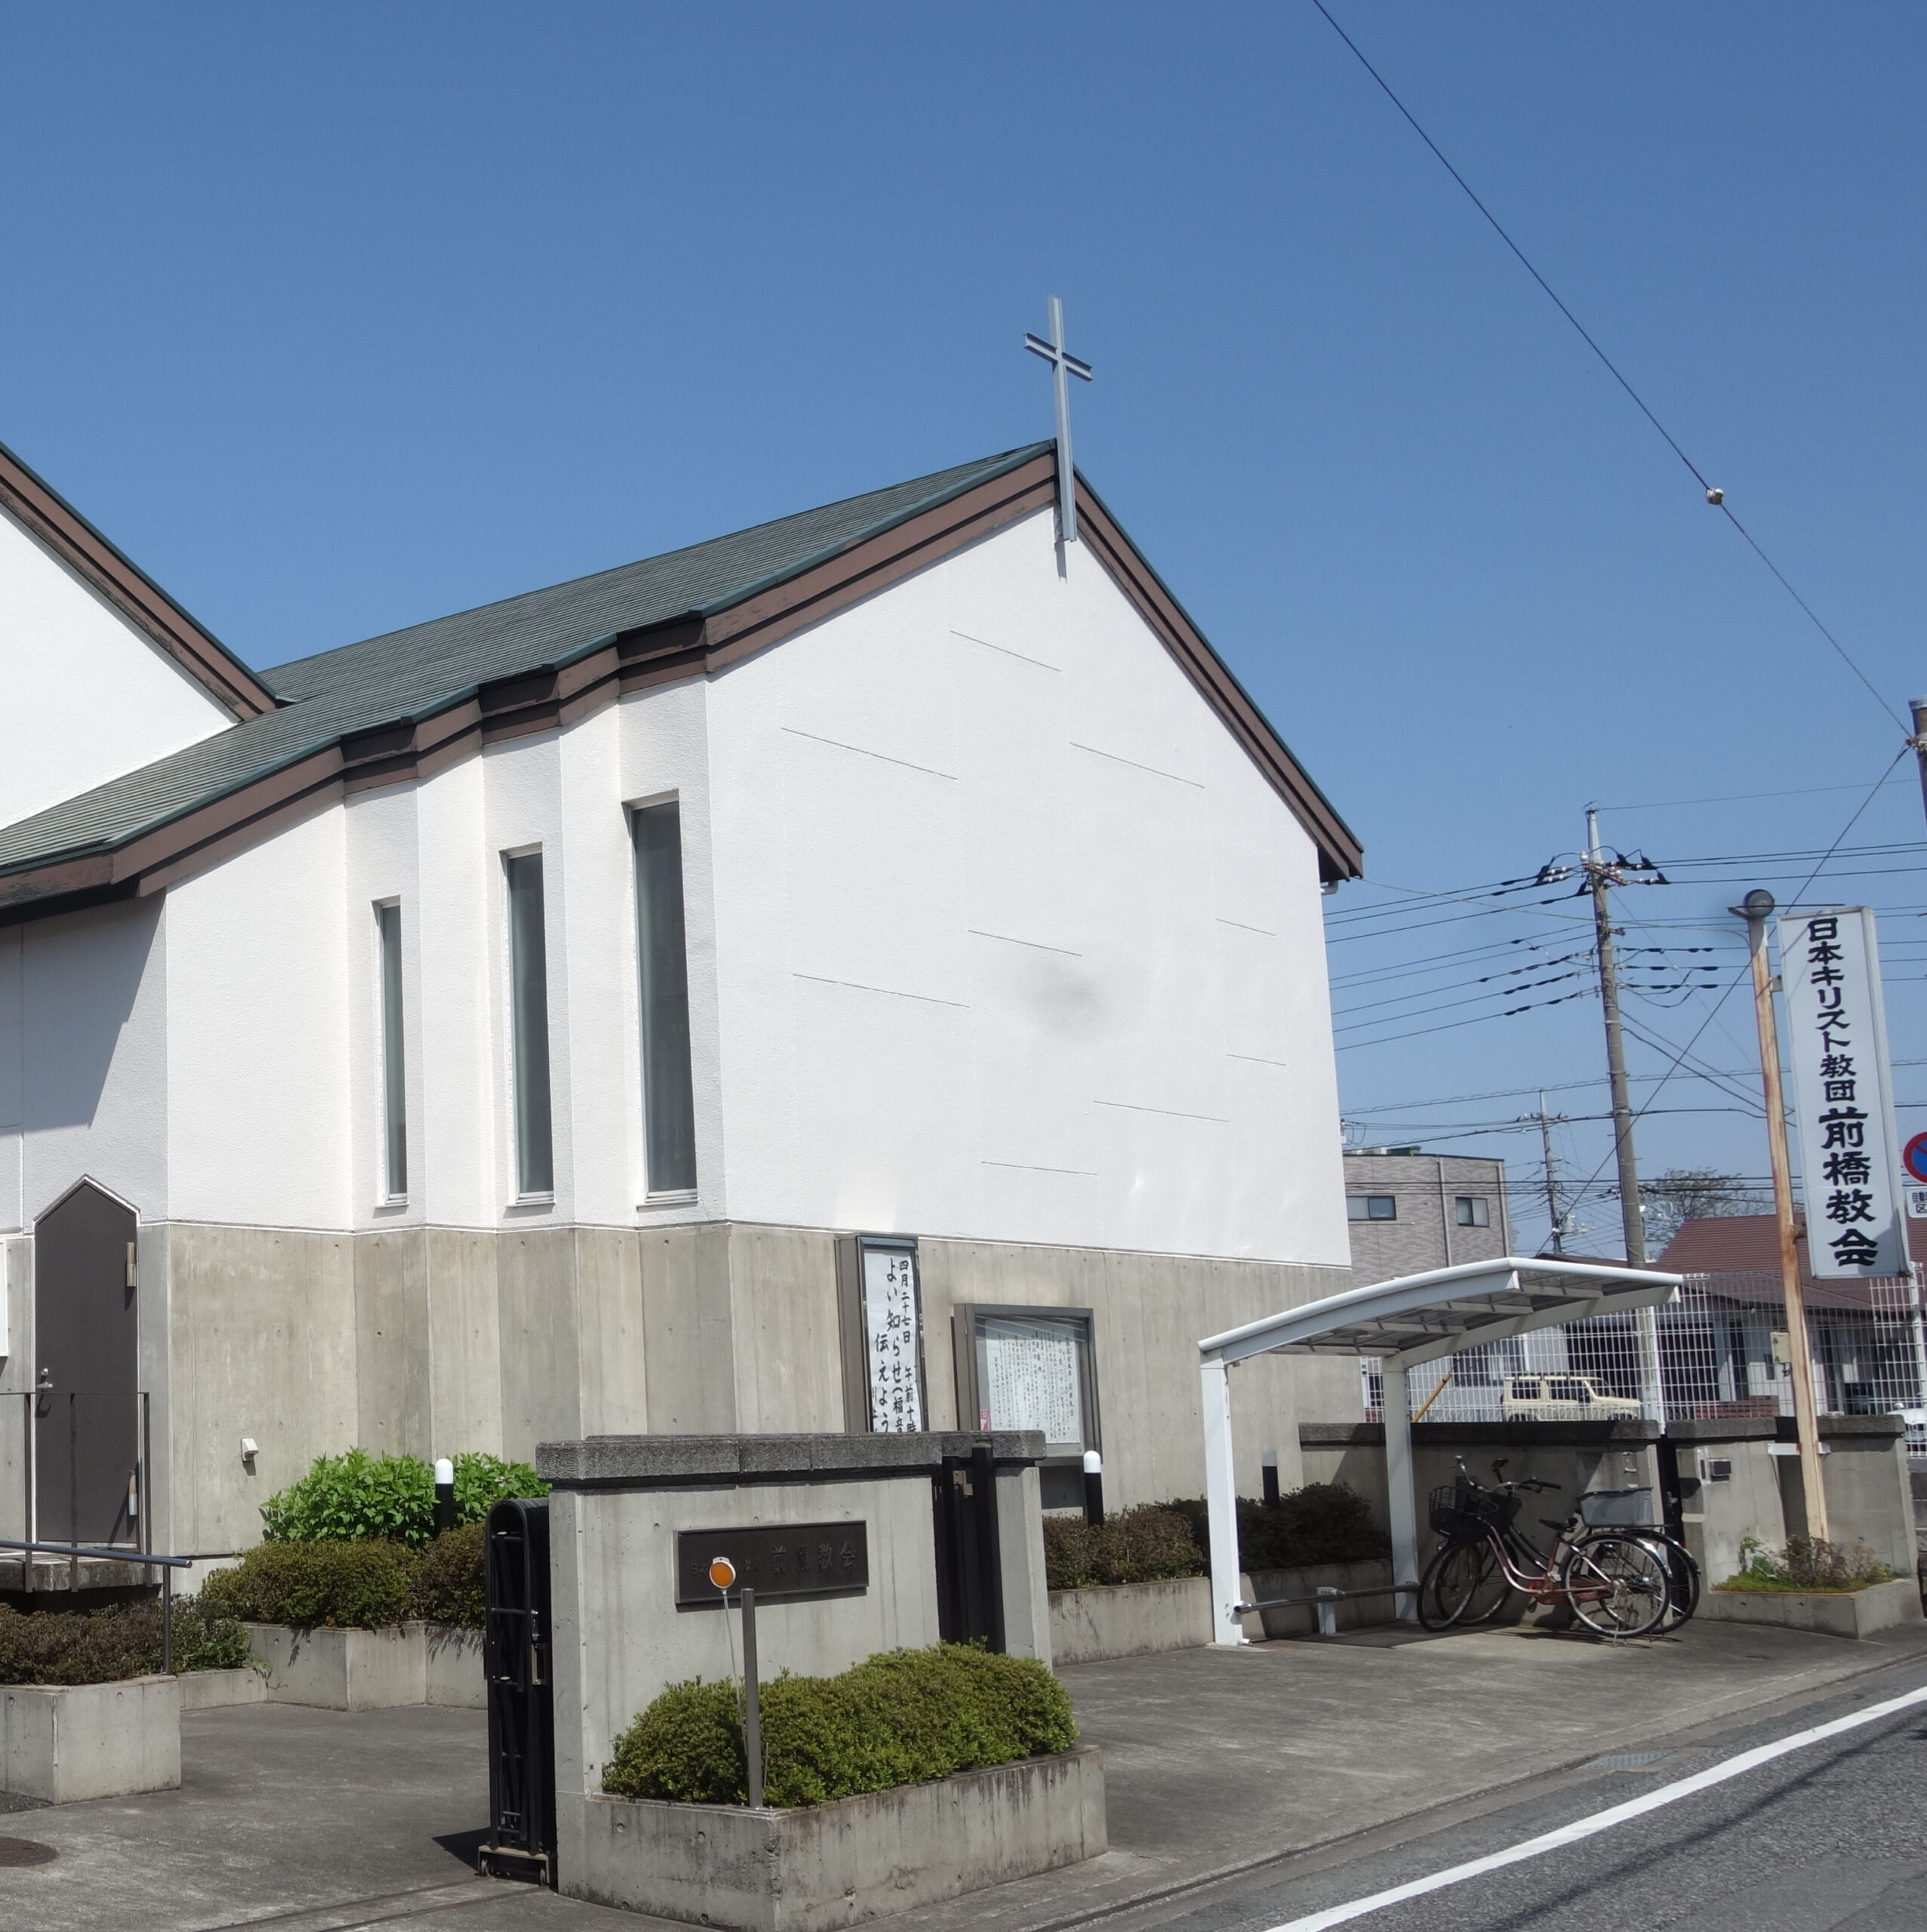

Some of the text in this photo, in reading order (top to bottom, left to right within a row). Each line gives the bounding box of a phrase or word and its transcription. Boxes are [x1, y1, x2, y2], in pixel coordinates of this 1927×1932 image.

[899, 1260, 912, 1343] 四月二十七日
[875, 1333, 890, 1432] 伝えよう
